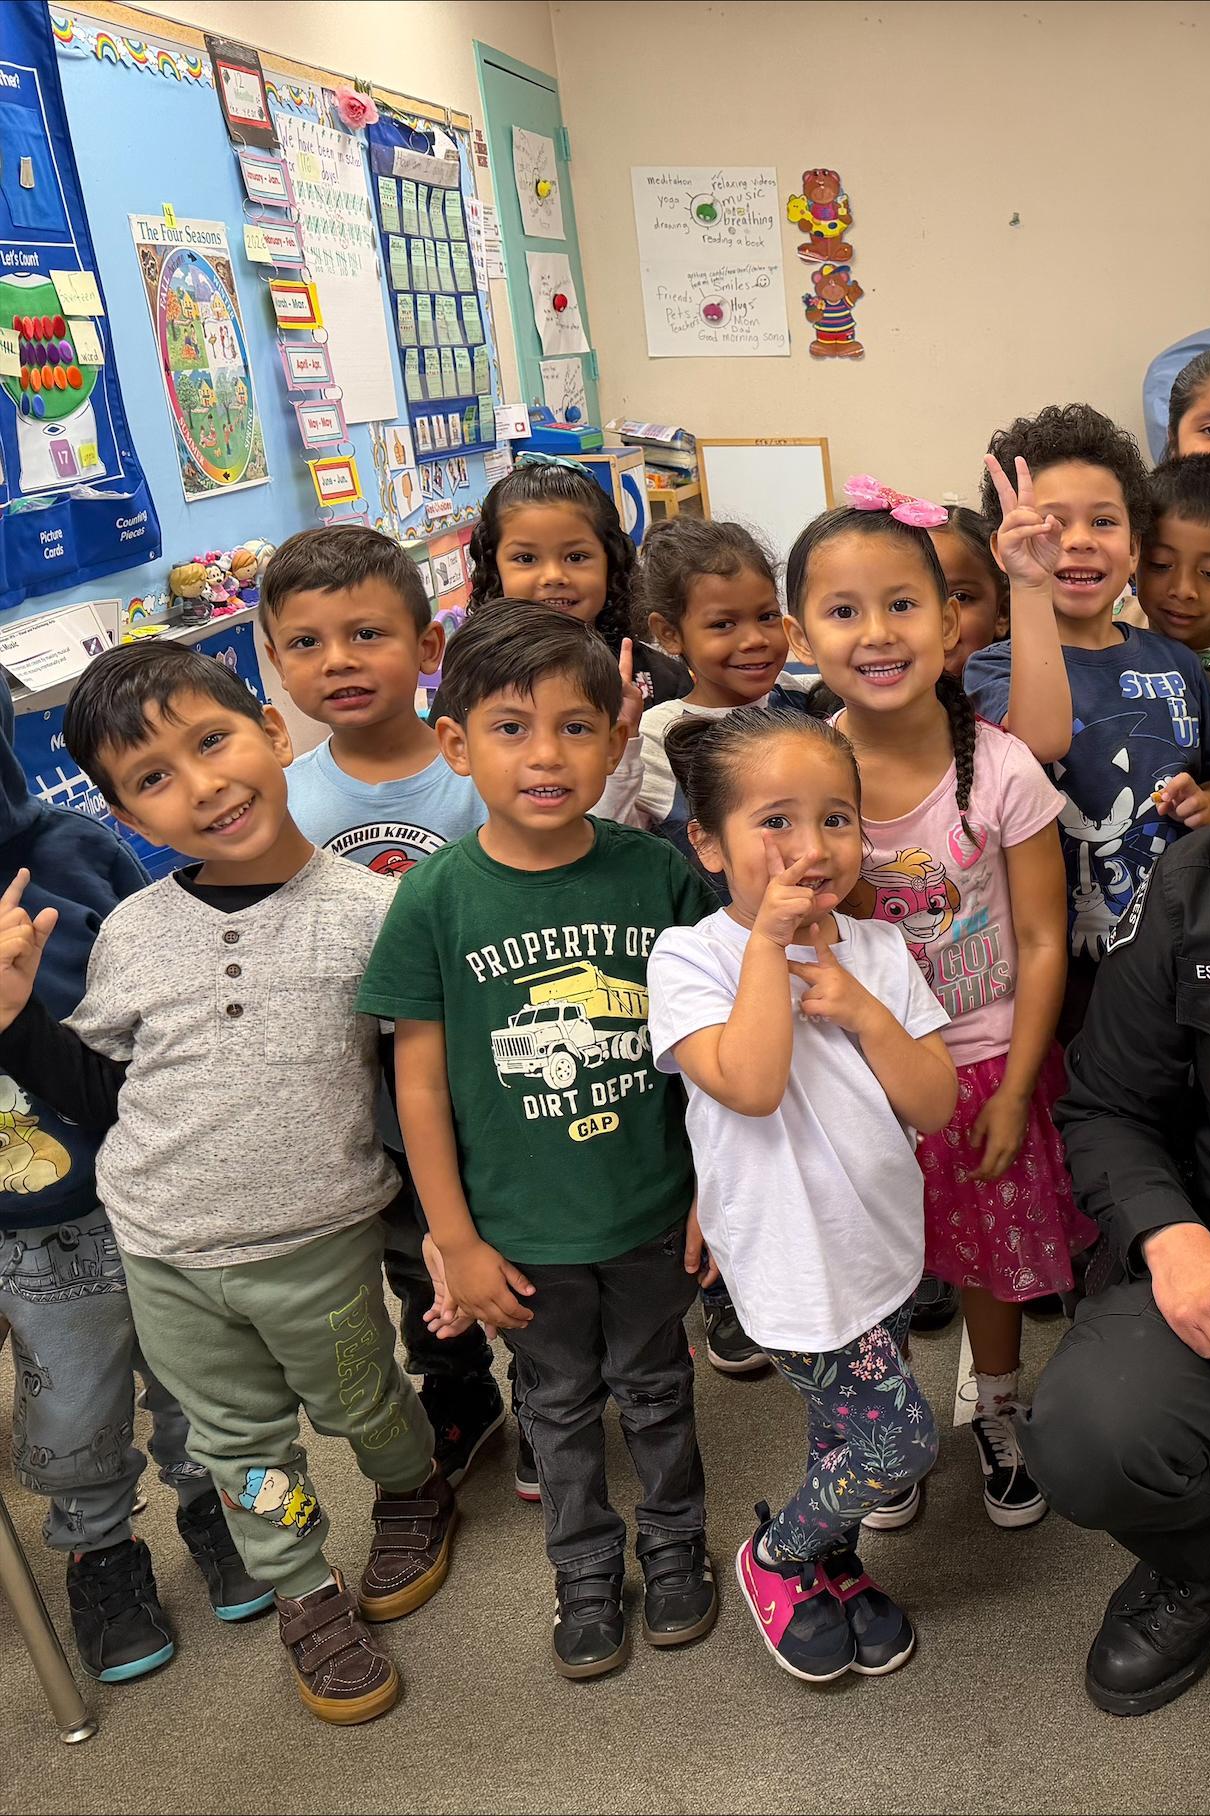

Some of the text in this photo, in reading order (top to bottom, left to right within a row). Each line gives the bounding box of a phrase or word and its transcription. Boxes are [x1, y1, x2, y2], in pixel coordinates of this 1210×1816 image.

[711, 174, 777, 191] relaxing videos
[657, 195, 680, 209] yoga
[722, 188, 765, 206] music
[654, 217, 690, 235] drawing
[723, 211, 773, 230] breathing
[137, 221, 222, 246] The Four Seasons
[702, 232, 733, 247] reading
[745, 235, 766, 247] book
[1, 249, 39, 267] Let's Count
[160, 275, 171, 311] FALL
[212, 275, 236, 320] WINTER
[731, 297, 758, 318] Hugs
[734, 315, 760, 326] Mom
[722, 331, 760, 349] morning
[763, 332, 785, 347] song
[245, 407, 254, 450] SPRING
[178, 416, 206, 467] SUMMER
[58, 450, 69, 465] 17
[116, 510, 148, 529] Counting
[40, 529, 63, 545] Picture
[120, 526, 145, 542] Pieces
[44, 544, 64, 559] Cards
[1119, 670, 1186, 699] STEP
[1166, 697, 1187, 718] IT
[331, 826, 431, 855] MARIO KART
[465, 923, 656, 983] PROPERTY OF
[939, 923, 1001, 984] GOT
[937, 960, 1015, 1018] THIS
[523, 1069, 655, 1120] DIRT DEPT.
[577, 1115, 613, 1138] GAP
